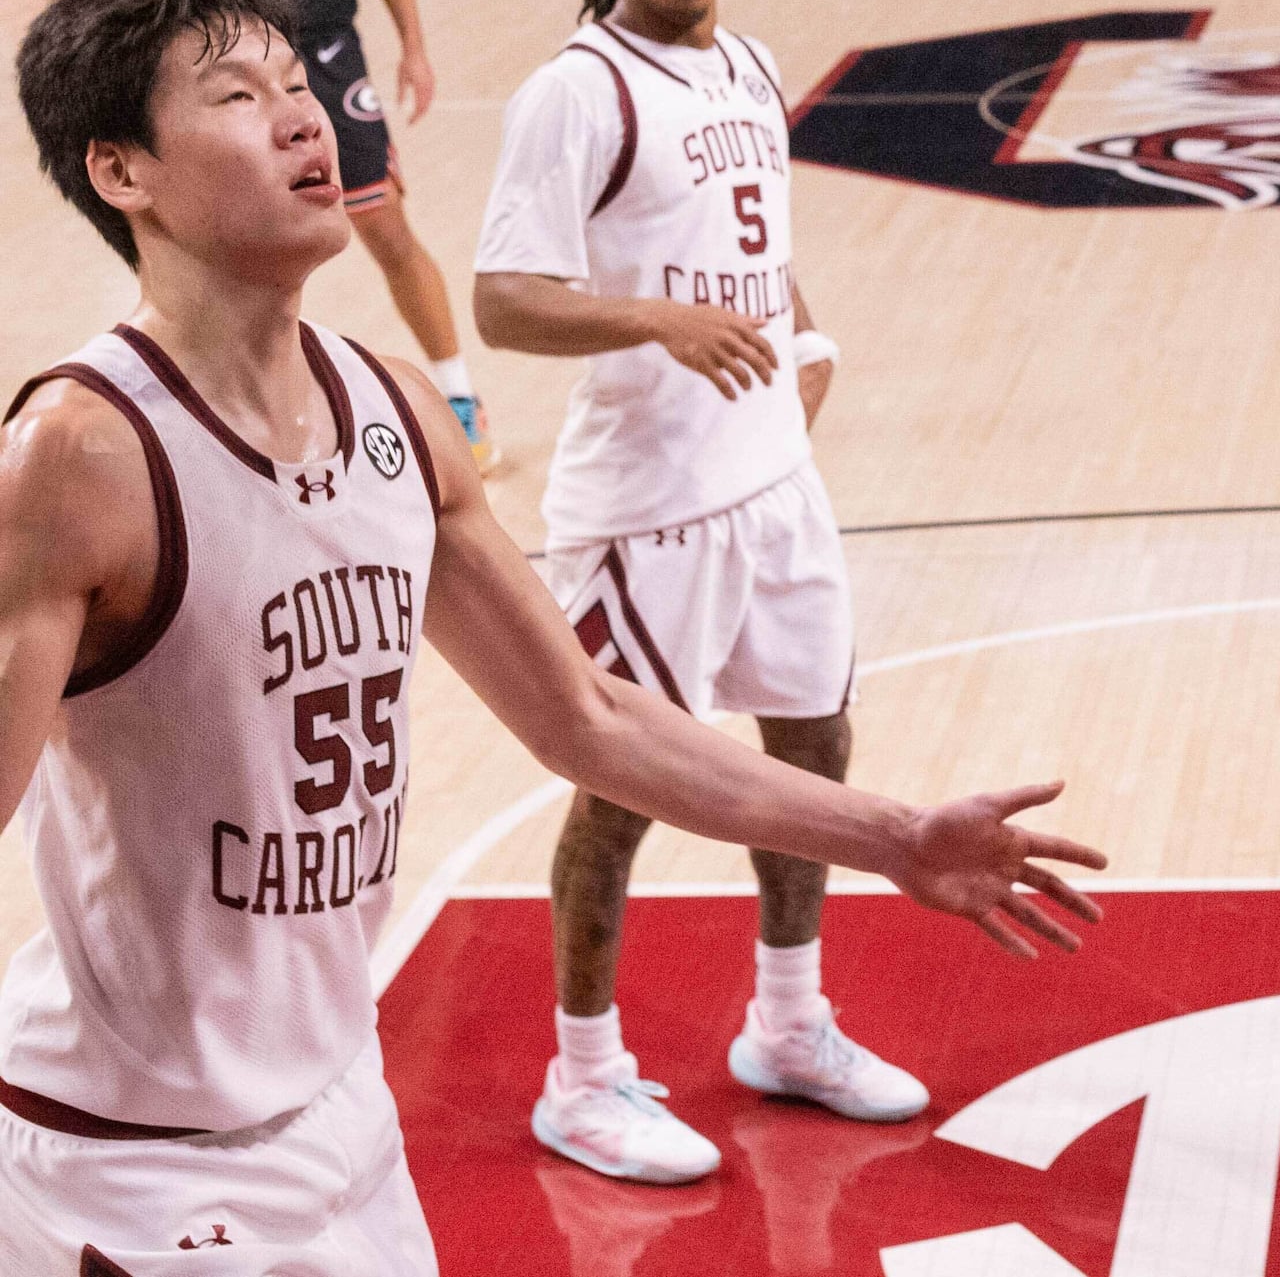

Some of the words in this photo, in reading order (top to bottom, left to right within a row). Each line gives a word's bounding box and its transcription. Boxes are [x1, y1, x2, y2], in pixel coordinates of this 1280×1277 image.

[683, 120, 784, 186] SOUTH
[733, 184, 768, 256] 5
[362, 423, 405, 480] SEC
[261, 566, 413, 695] SOUTH
[294, 667, 404, 815] 55
